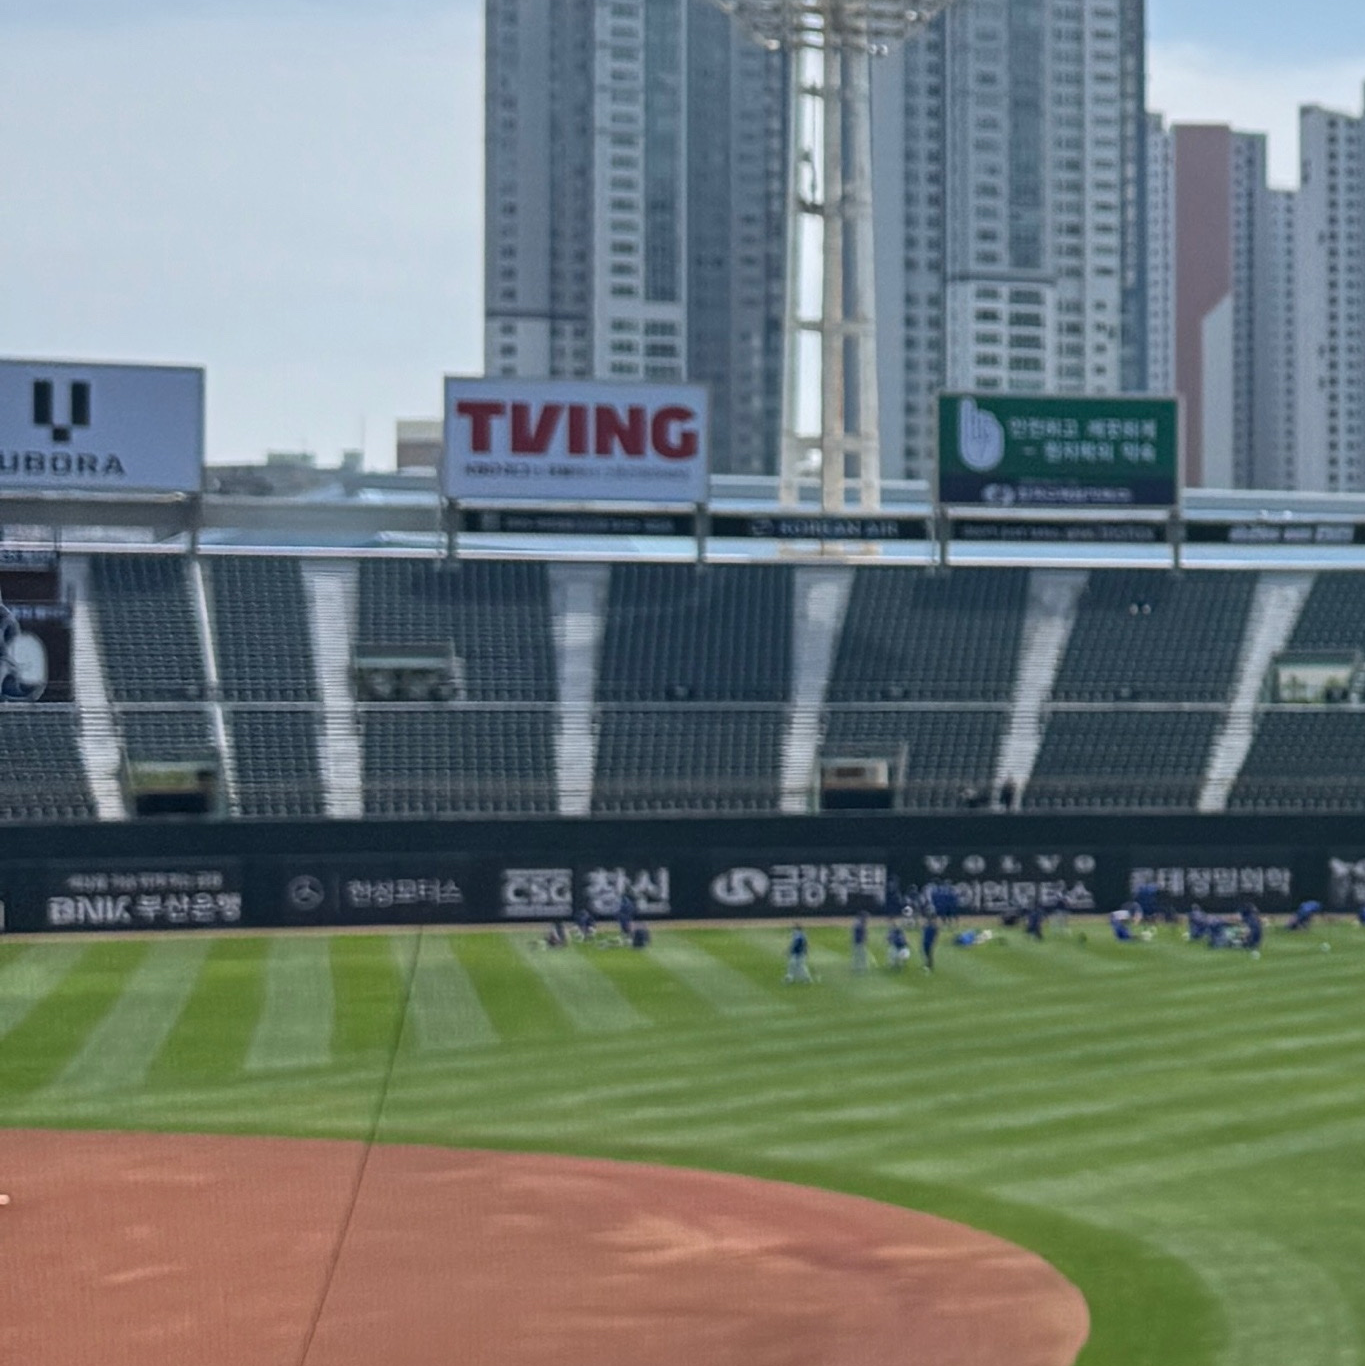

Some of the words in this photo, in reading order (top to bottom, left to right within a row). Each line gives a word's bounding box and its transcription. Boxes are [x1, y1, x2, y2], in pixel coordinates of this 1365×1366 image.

[456, 399, 698, 459] TVING
[48, 895, 131, 925] BNK
[134, 891, 242, 923] 부산은행
[586, 866, 671, 915] 창신
[771, 864, 887, 908] 금강주택
[925, 879, 1097, 911] 이언모터스
